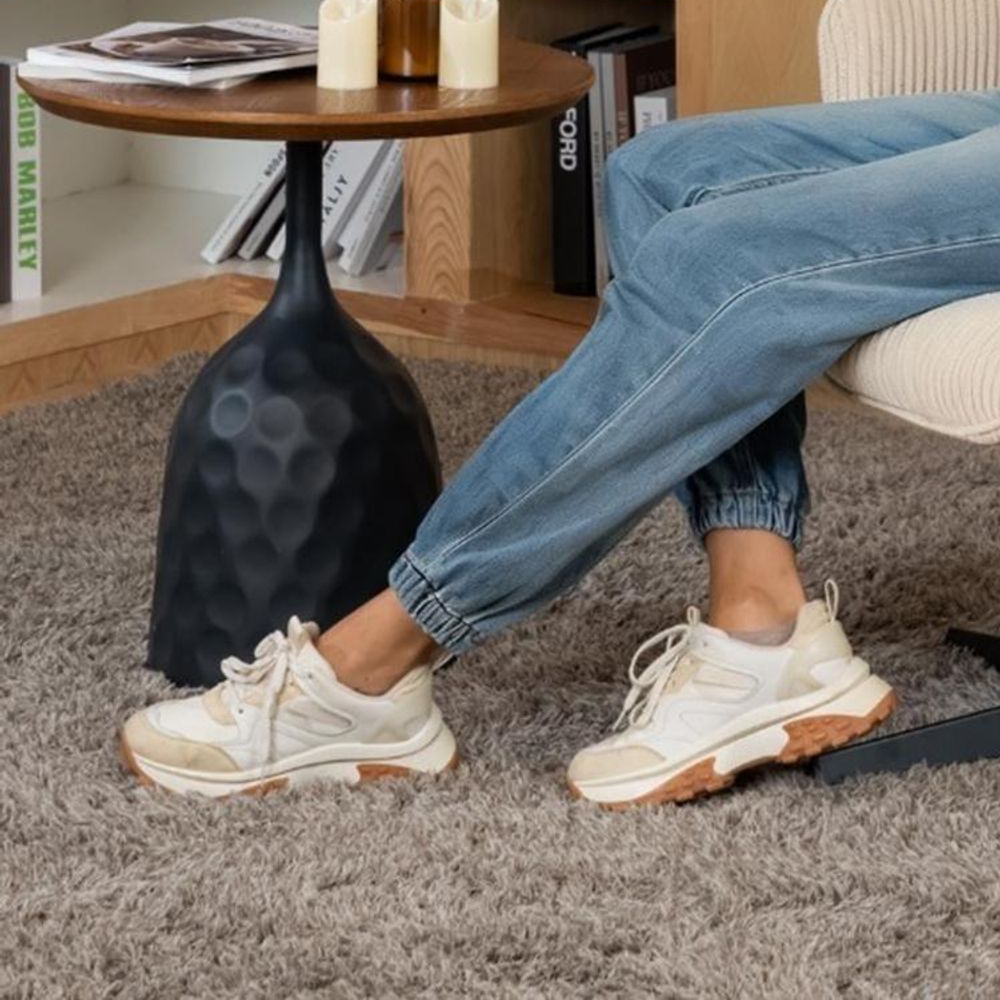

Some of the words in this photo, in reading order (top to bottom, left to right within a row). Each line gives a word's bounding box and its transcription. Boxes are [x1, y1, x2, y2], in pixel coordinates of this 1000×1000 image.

[18, 93, 38, 149] BOB
[559, 107, 577, 171] FORD
[18, 161, 38, 271] MARLEY
